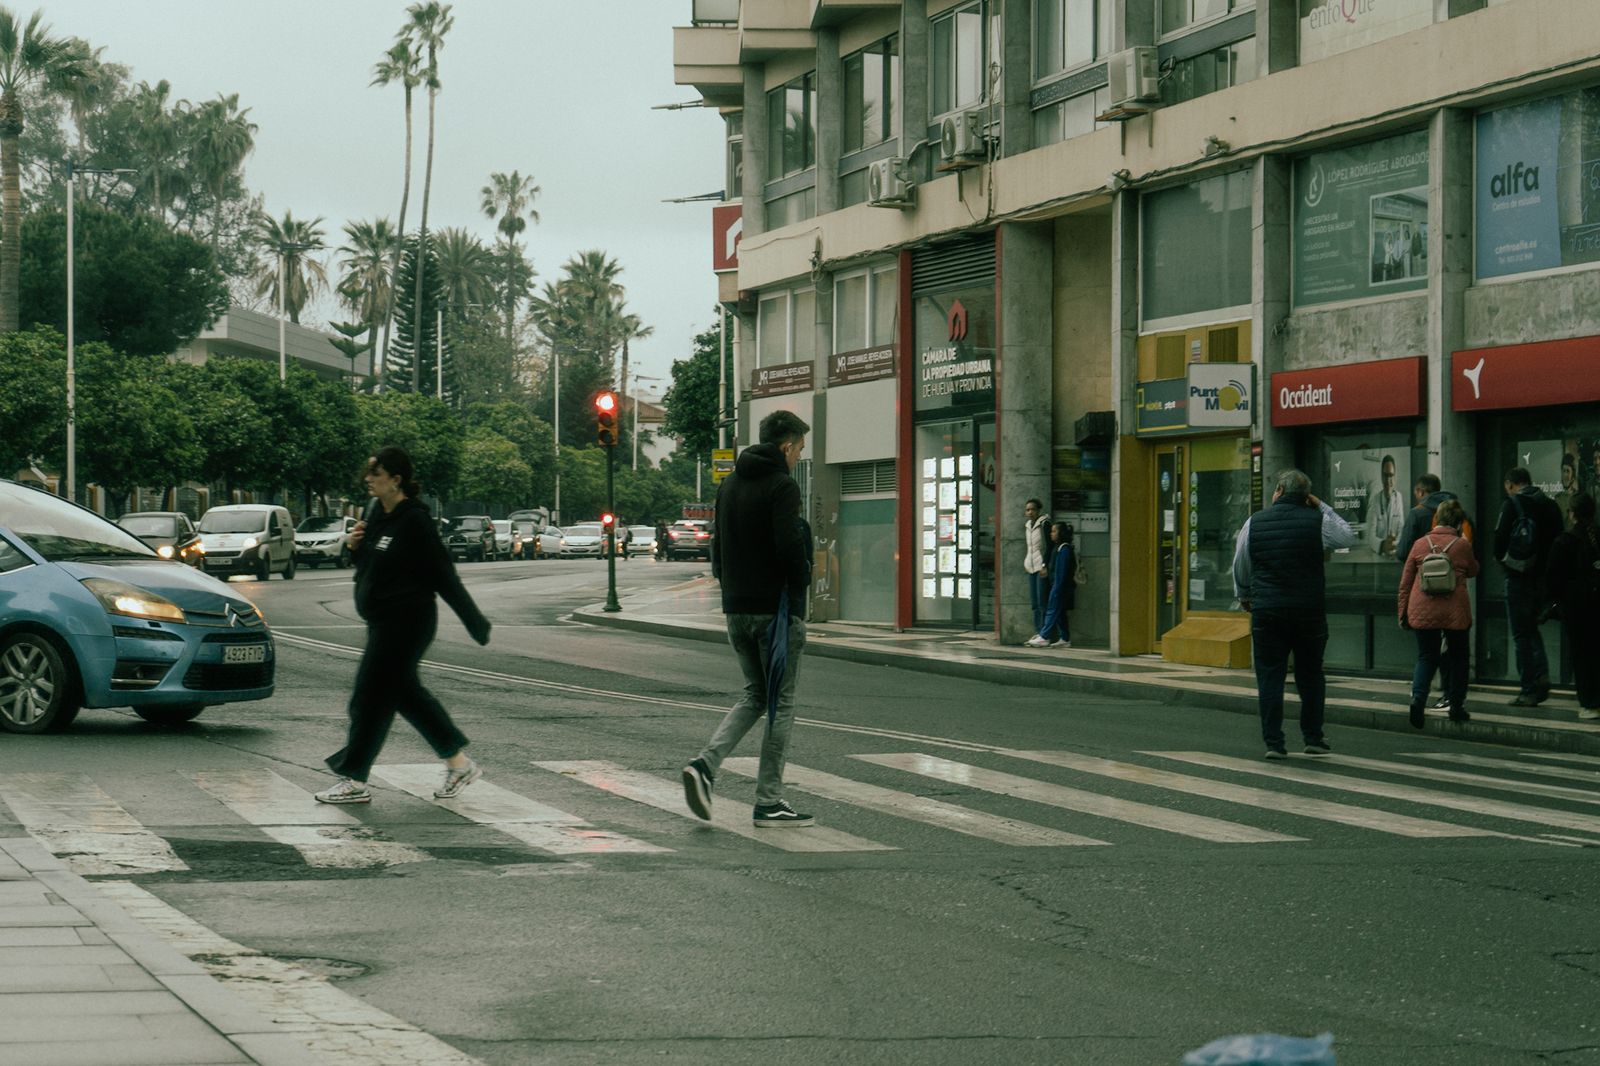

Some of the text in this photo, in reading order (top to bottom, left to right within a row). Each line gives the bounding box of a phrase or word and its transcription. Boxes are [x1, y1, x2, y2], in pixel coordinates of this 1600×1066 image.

[1349, 159, 1389, 178] RODRÍGUEZ
[1490, 161, 1540, 199] alfa
[922, 347, 957, 366] CÁMARA DE
[922, 359, 993, 382] LA PROPIEDAD URBANA
[922, 376, 993, 398] DE HUELVA Y PROVNCIA
[1280, 384, 1333, 409] Occident
